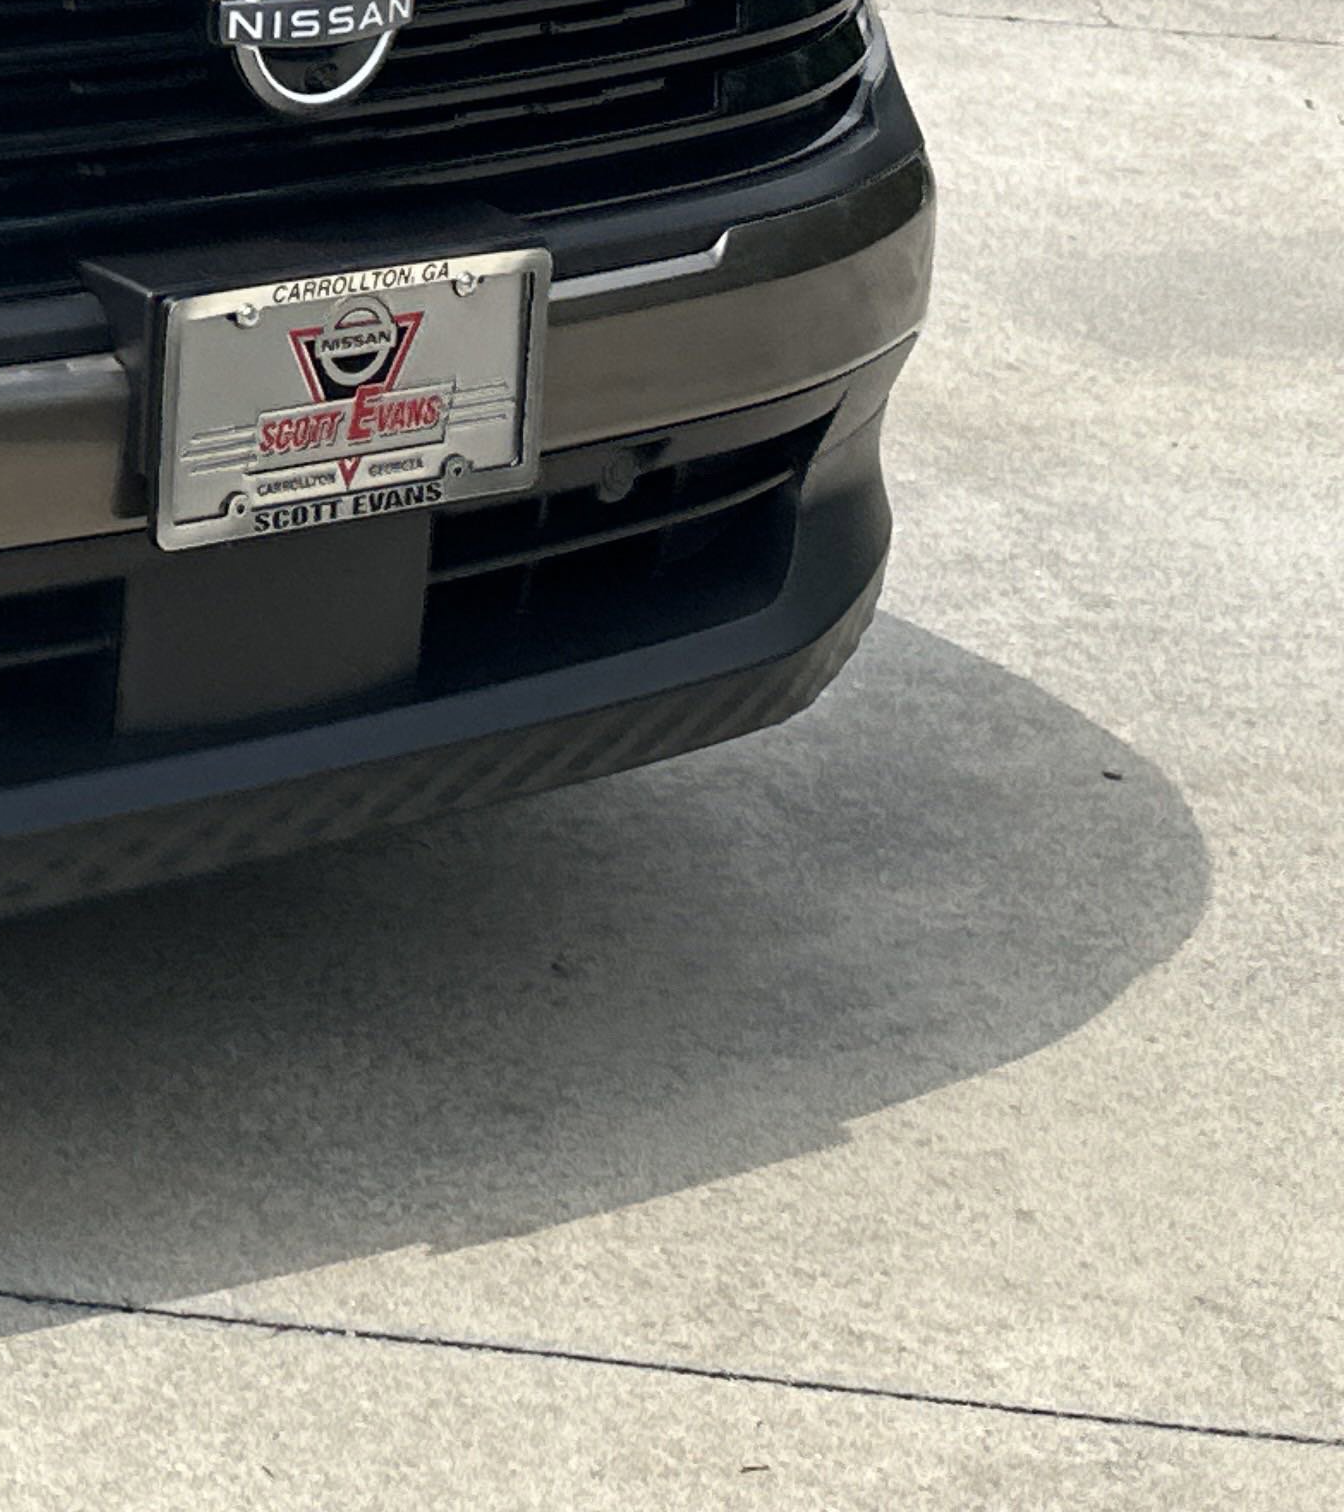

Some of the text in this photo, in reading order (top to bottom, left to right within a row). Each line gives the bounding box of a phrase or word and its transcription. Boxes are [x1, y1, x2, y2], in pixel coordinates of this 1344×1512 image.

[421, 262, 449, 282] GA
[321, 331, 391, 352] NISSAN
[259, 410, 343, 453] SCOTT
[256, 472, 337, 497] CARROLLTON
[253, 481, 443, 533] SCOTT EVANS
